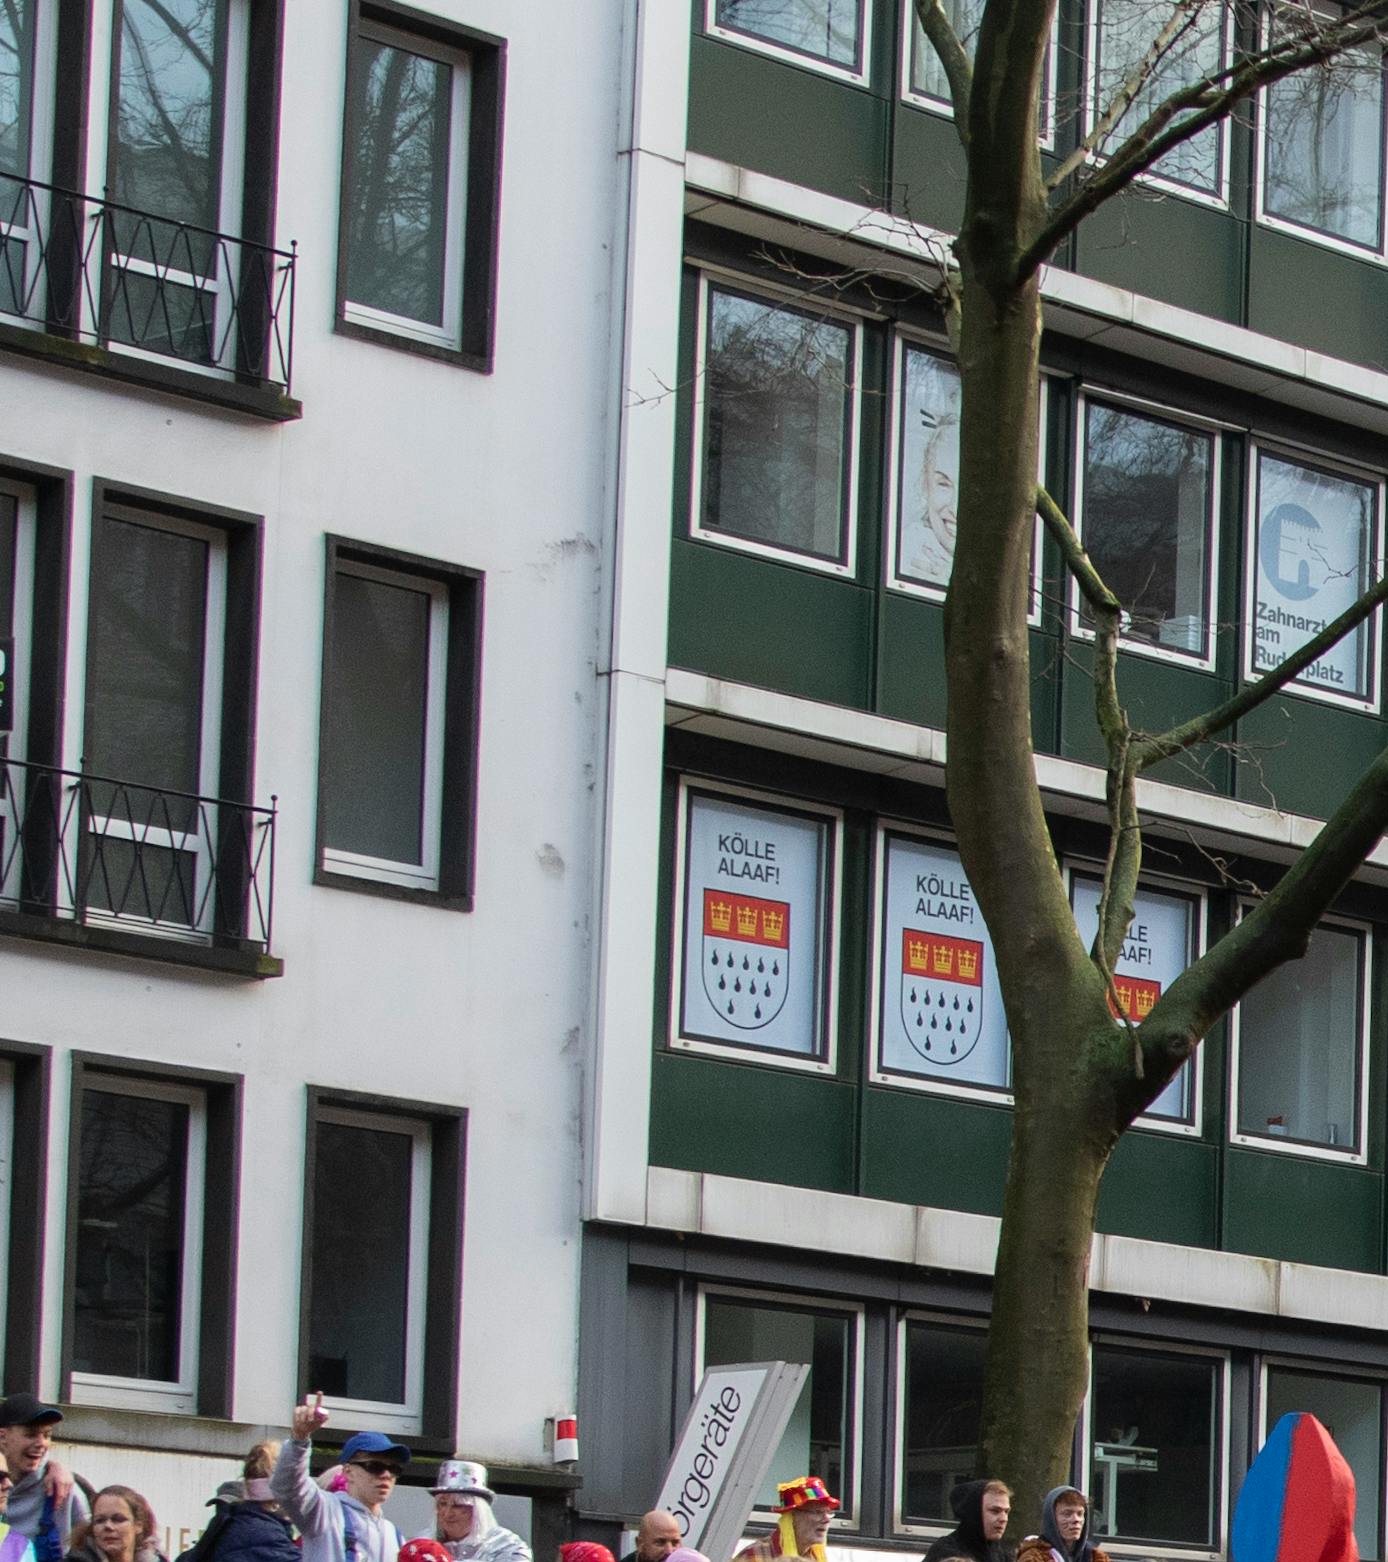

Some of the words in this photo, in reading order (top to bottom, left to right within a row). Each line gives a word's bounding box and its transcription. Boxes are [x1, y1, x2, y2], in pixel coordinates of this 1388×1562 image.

[1257, 601, 1328, 634] Zahnarzt
[1256, 626, 1280, 645] am
[1256, 645, 1344, 684] Rudplatz
[718, 832, 776, 861] KÖLLE
[717, 857, 781, 885] ALAAF!
[916, 872, 970, 901] KÖLLE
[915, 897, 974, 924] ALAAF!
[1120, 944, 1152, 965] AAF!
[667, 1386, 741, 1538] örgeräte
